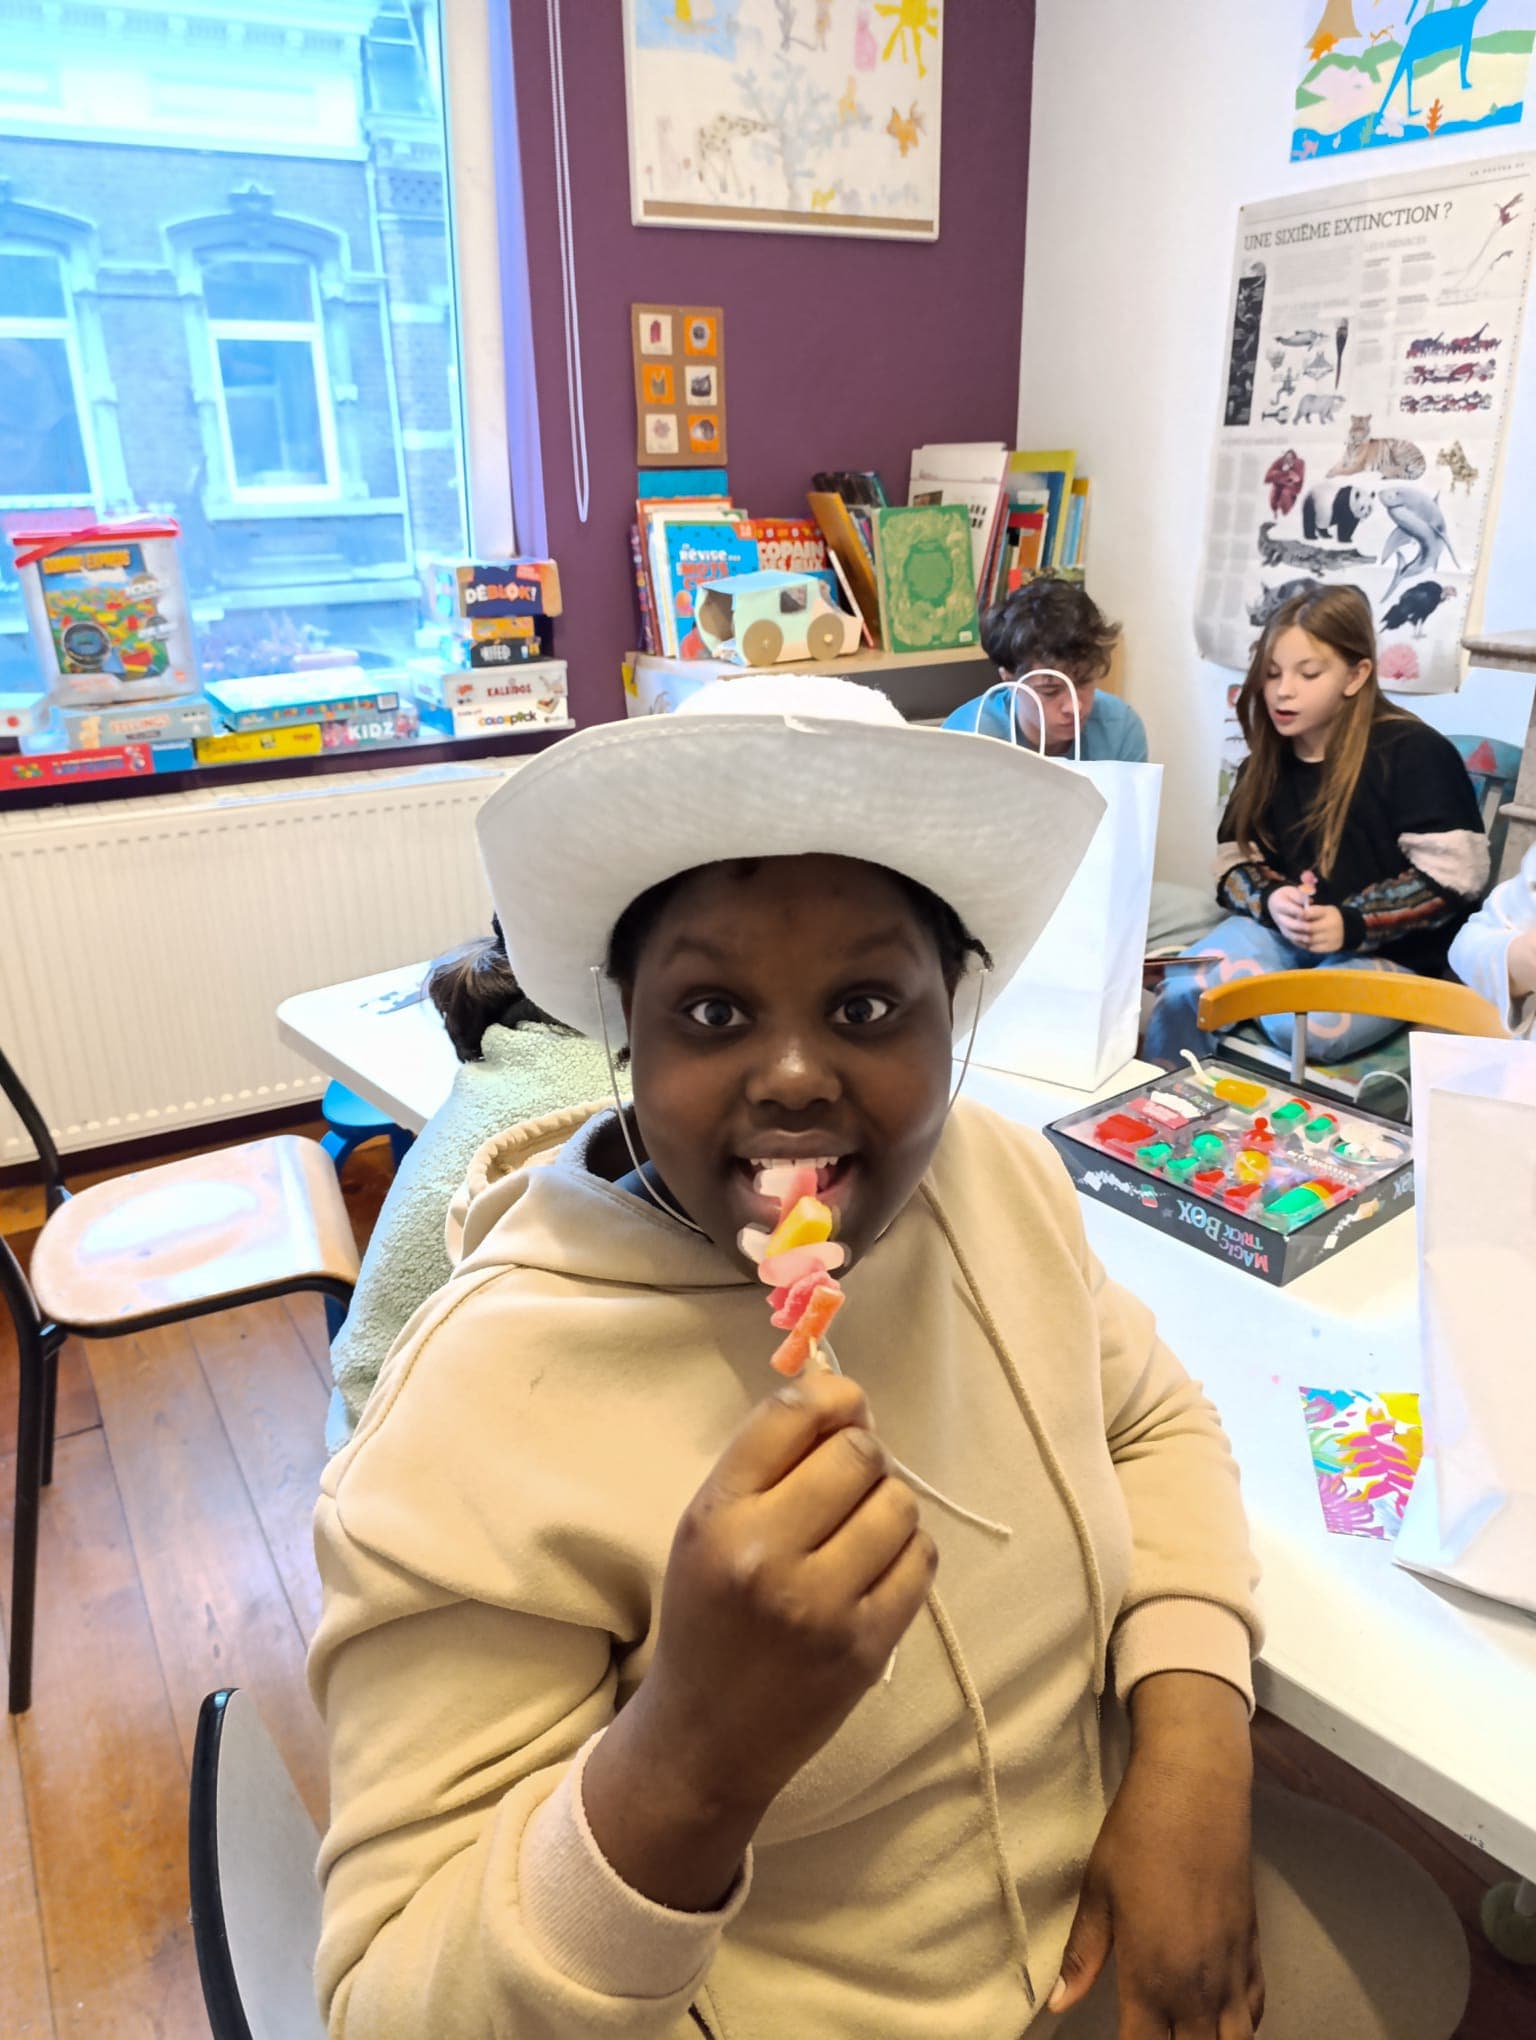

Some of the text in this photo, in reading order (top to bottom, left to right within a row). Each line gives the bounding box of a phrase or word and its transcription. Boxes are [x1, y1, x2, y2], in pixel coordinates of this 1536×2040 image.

[1244, 232, 1272, 251] UNE
[1334, 204, 1439, 236] EXTINCTION
[1443, 201, 1453, 219] ?
[758, 540, 824, 558] COPAIN
[487, 683, 532, 698] KALEIDOS
[347, 721, 396, 740] KIDZ
[1176, 1199, 1222, 1242] BOX
[1222, 1224, 1264, 1251] TRICK
[1218, 1237, 1269, 1273] MAGIC
